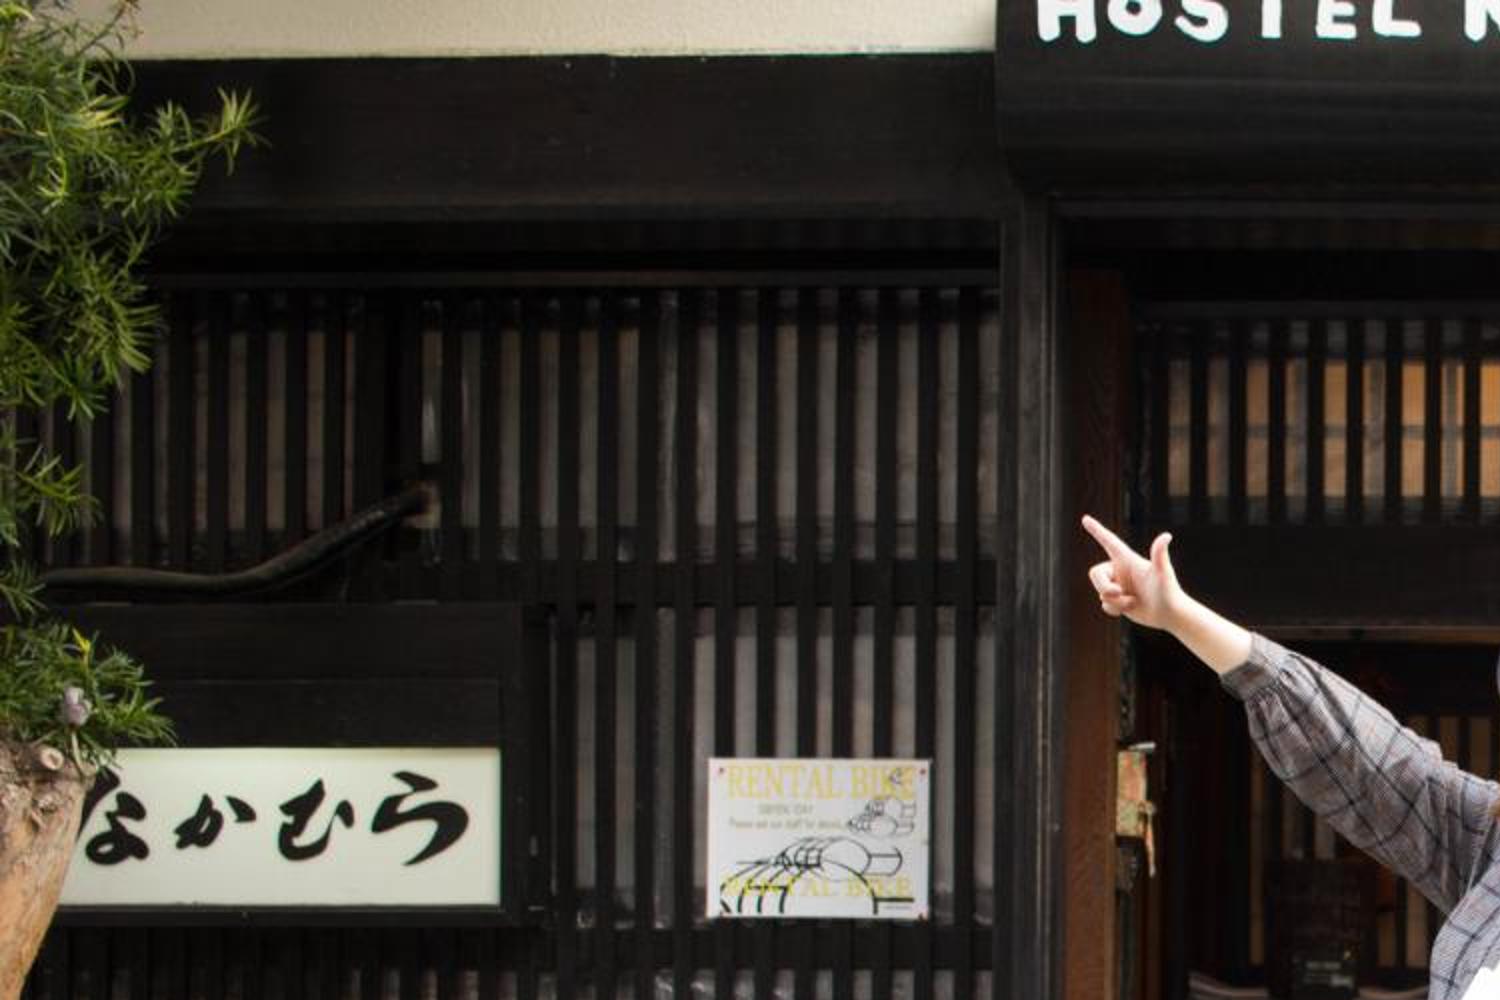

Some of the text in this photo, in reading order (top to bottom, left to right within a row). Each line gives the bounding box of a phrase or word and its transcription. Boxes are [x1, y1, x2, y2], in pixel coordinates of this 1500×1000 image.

[1037, 0, 1421, 42] HOSTEL
[728, 766, 848, 799] RENTAL
[76, 764, 470, 866] なかむら
